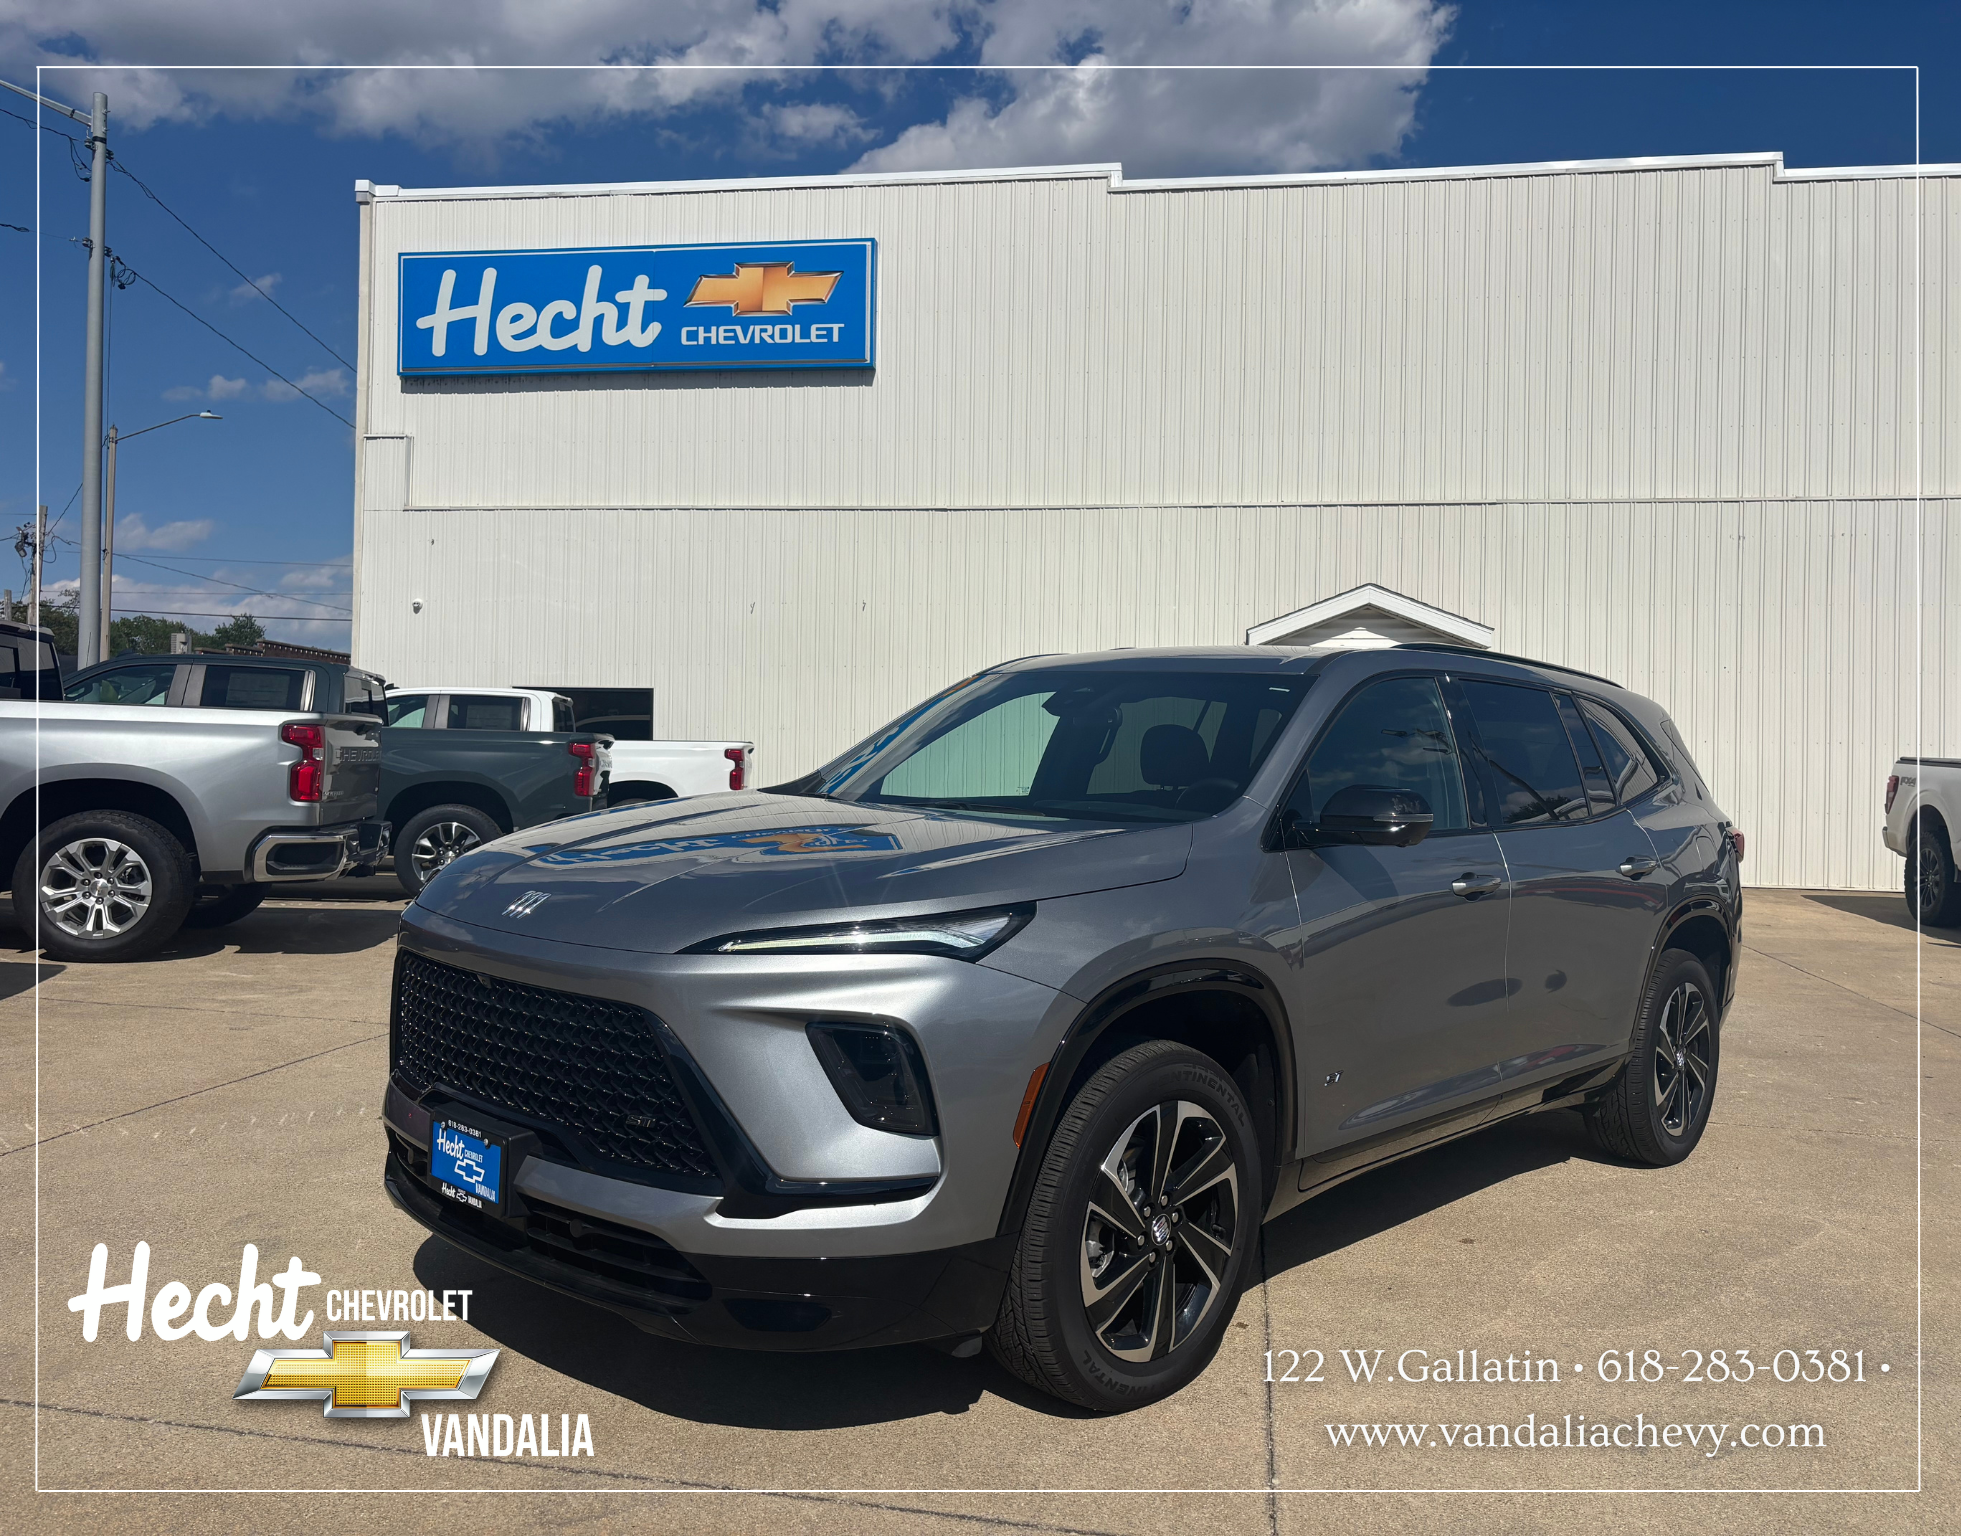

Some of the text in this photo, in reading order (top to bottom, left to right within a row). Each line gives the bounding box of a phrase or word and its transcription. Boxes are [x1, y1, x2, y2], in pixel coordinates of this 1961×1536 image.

[416, 264, 668, 357] Hecht
[681, 323, 845, 346] CHEVROLET
[1149, 1070, 1245, 1127] NTINENTAL
[437, 1128, 483, 1163] Hecht CHEVROLET
